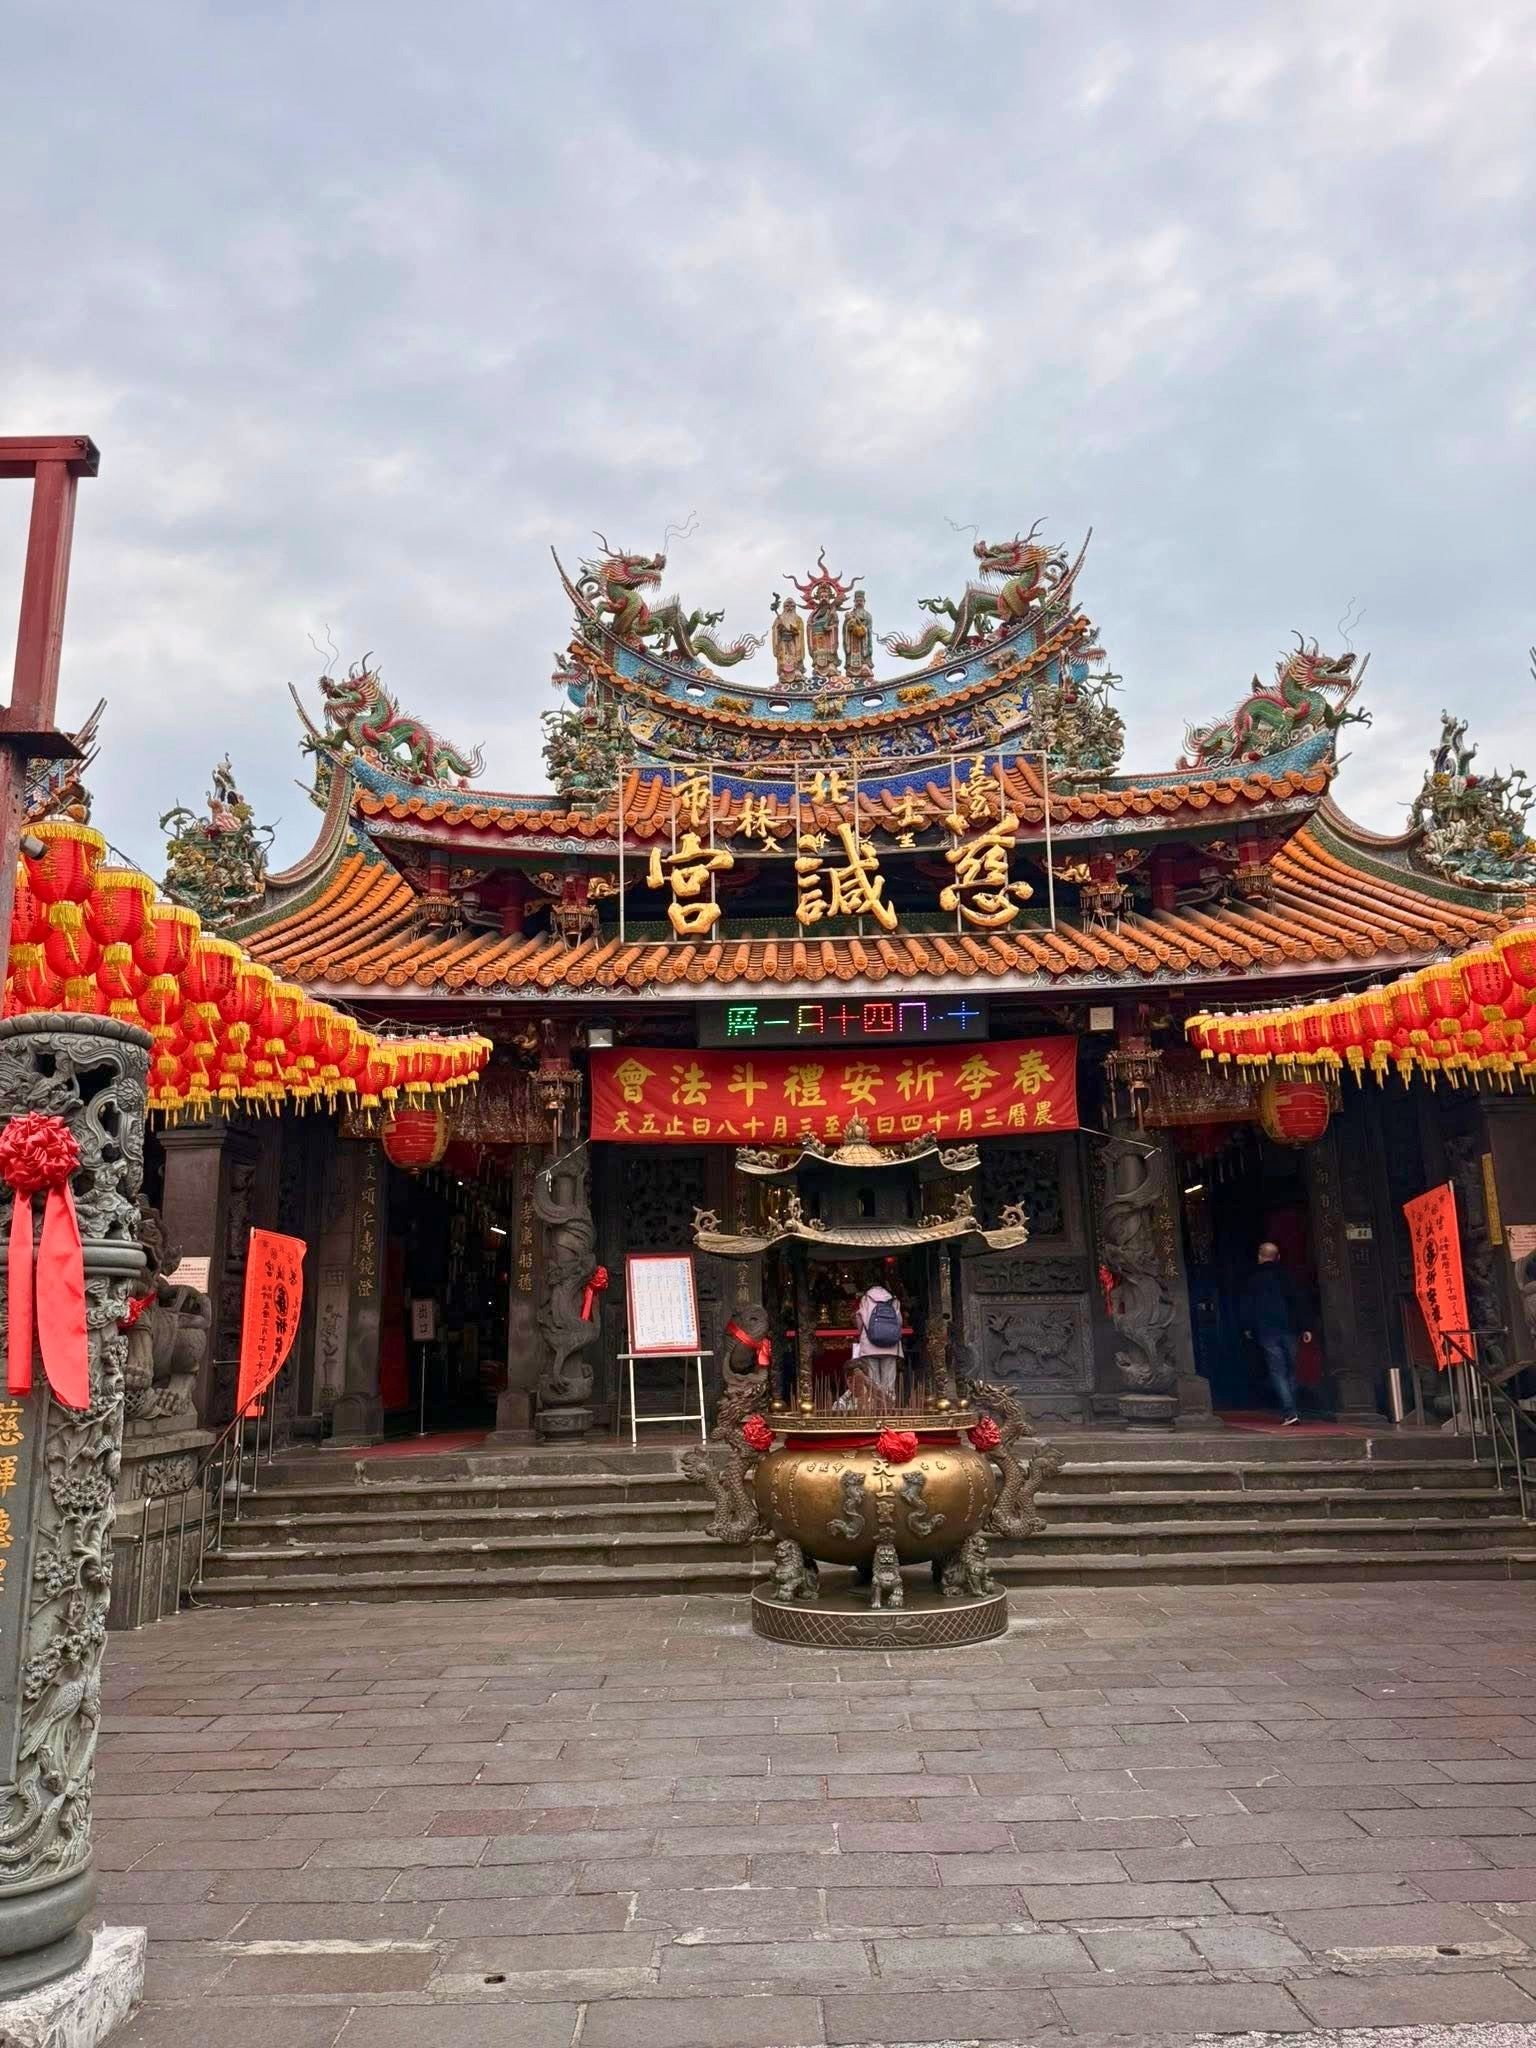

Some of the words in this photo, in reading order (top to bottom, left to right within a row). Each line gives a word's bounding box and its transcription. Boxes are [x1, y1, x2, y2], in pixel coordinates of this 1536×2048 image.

[612, 1049, 1056, 1108] 春季祈安禮斗法會
